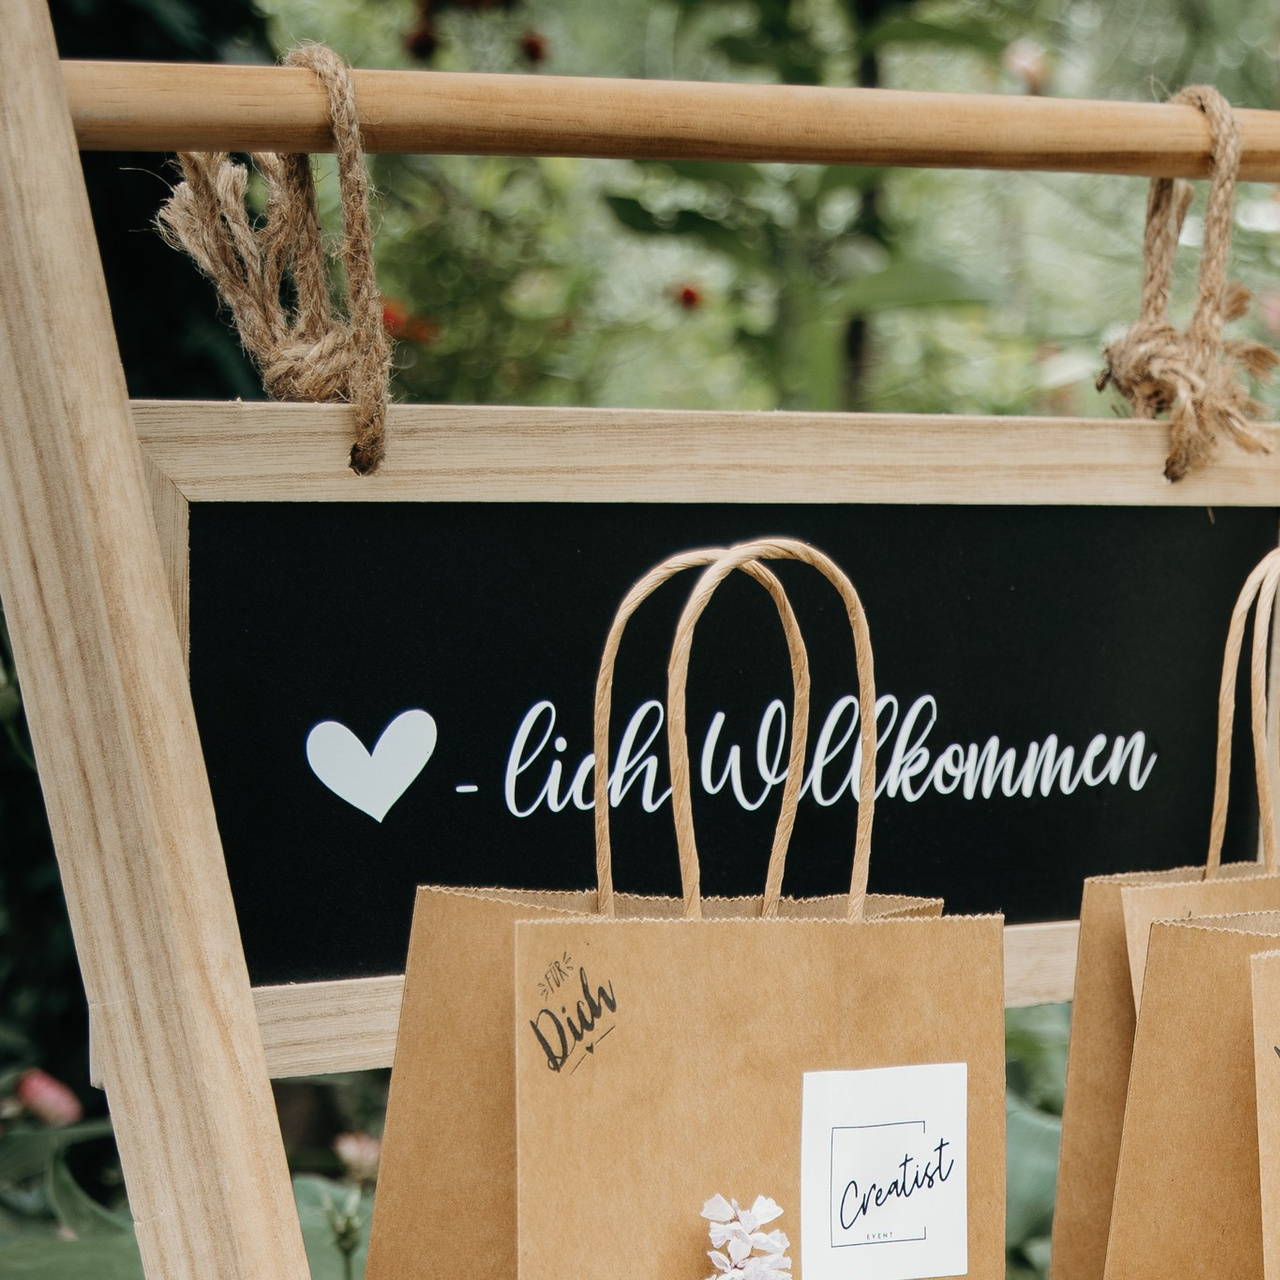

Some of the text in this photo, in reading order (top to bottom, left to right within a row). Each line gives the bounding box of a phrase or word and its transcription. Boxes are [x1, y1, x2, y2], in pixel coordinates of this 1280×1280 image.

[700, 694, 1158, 811] Wllkommen
[529, 966, 617, 1073] Dich
[544, 959, 569, 994] FÜR
[839, 1137, 954, 1231] Creatist
[866, 1231, 893, 1241] EVENT
